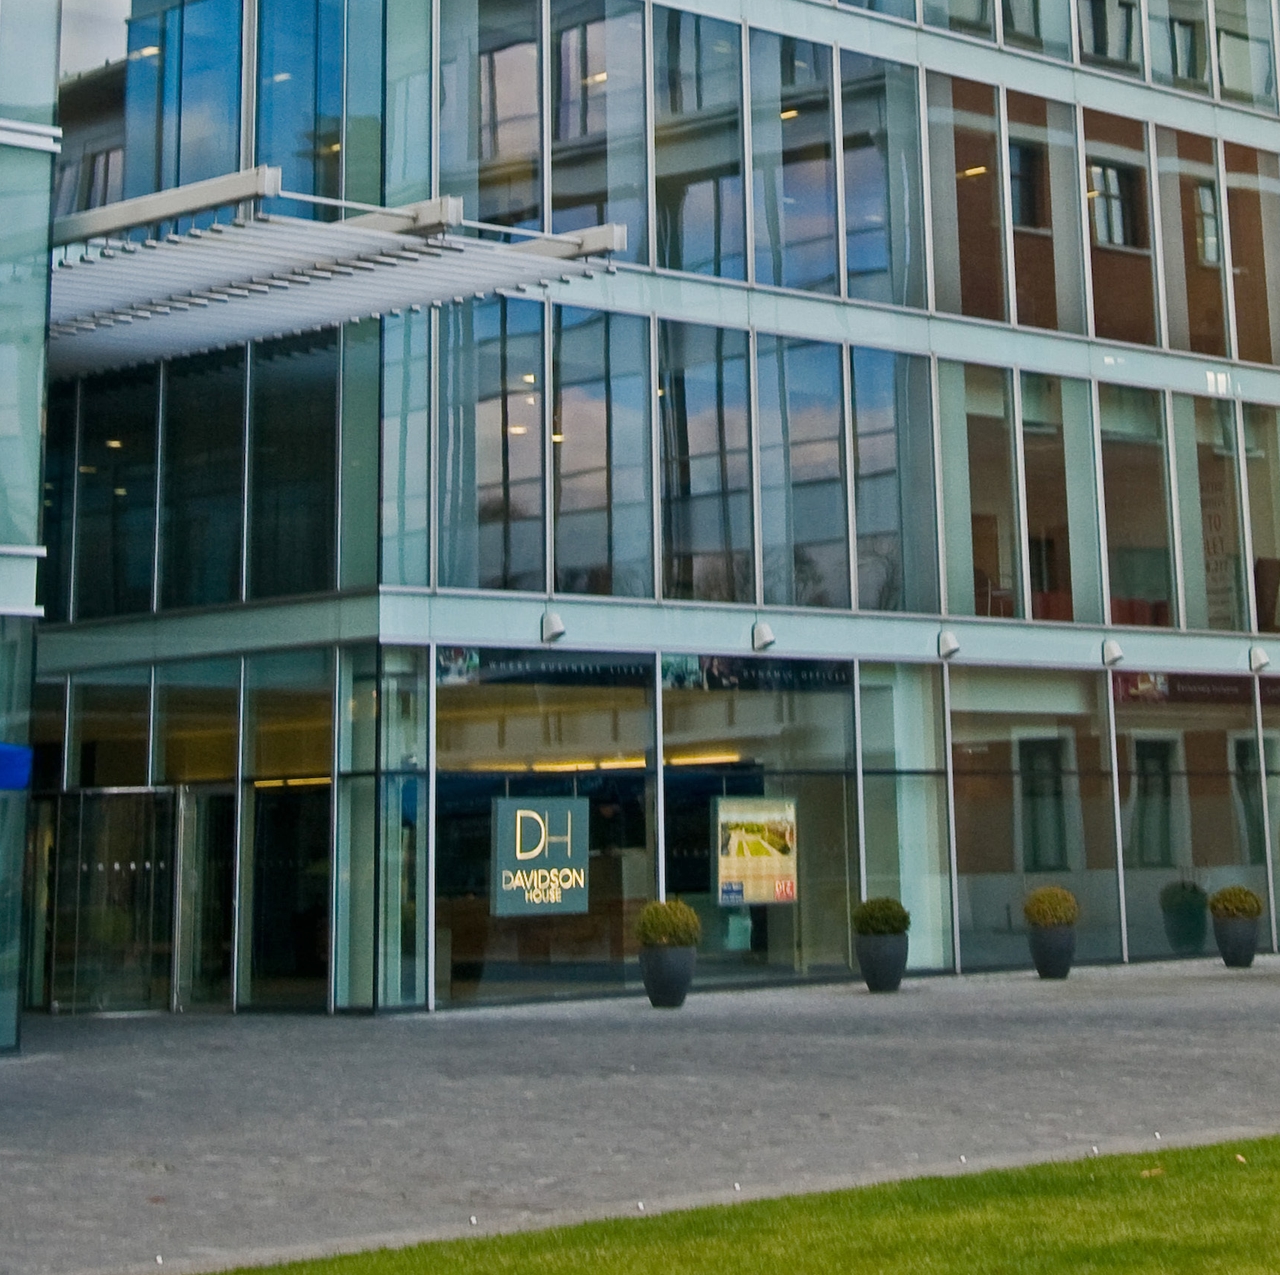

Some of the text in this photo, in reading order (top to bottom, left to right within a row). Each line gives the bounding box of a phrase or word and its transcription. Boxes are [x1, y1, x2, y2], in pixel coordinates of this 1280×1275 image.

[515, 809, 572, 860] DH
[502, 868, 585, 891] DAVIDSON
[525, 887, 562, 904] HOUSE
